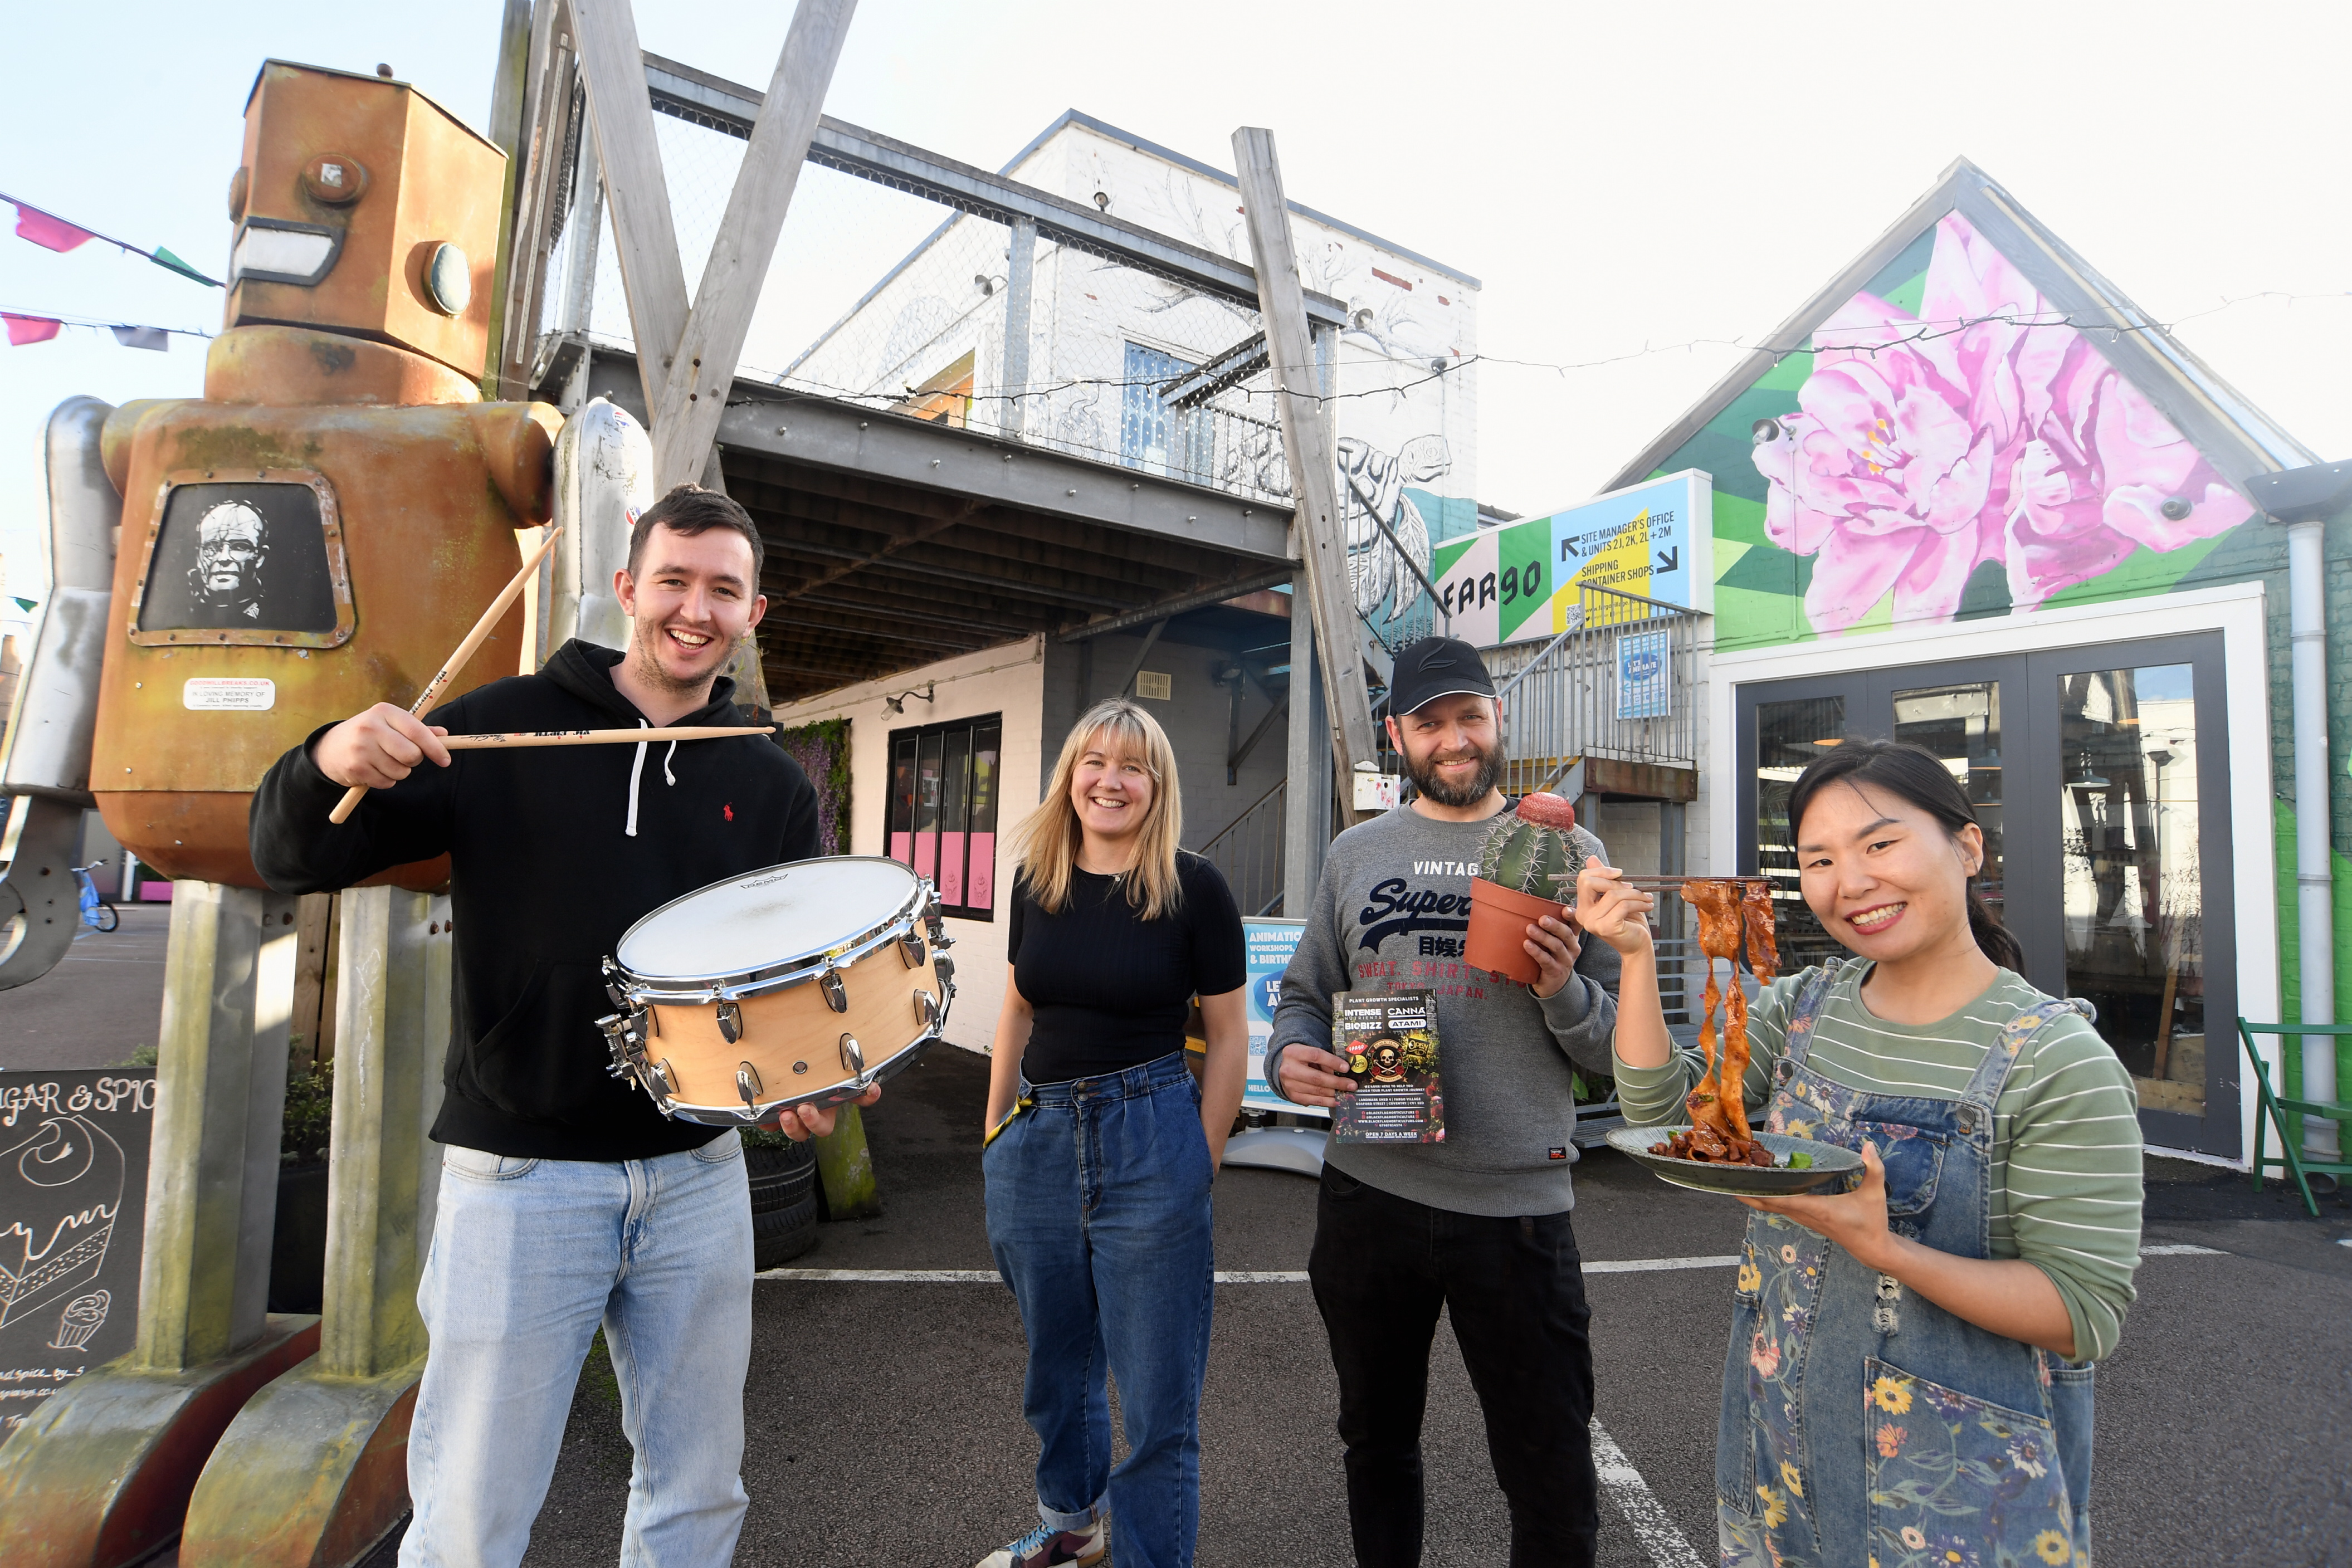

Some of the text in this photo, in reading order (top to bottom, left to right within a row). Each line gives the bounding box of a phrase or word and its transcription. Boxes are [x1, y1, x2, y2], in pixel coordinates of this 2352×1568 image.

[1582, 511, 1674, 544] SITE MANAGER'S OFFICE
[1582, 547, 1587, 557] &
[1589, 540, 1612, 555] UNITS
[1613, 538, 1624, 550] 2J,
[1626, 534, 1638, 548] 2K,
[1639, 531, 1649, 543] 2L
[1658, 525, 1671, 539] 2M
[1582, 559, 1618, 577] SHIPPING
[1627, 565, 1654, 580] SHOPS
[1250, 954, 1257, 964] &
[1358, 961, 1401, 978] SWEAT.
[1412, 961, 1480, 981] SHIRT.
[1437, 984, 1487, 1000] JAPAN.
[1344, 1008, 1382, 1017] INTENSE
[1344, 1022, 1382, 1030] BIOBIZZ
[1248, 1084, 1273, 1092] HELLO
[67, 1085, 93, 1111] &
